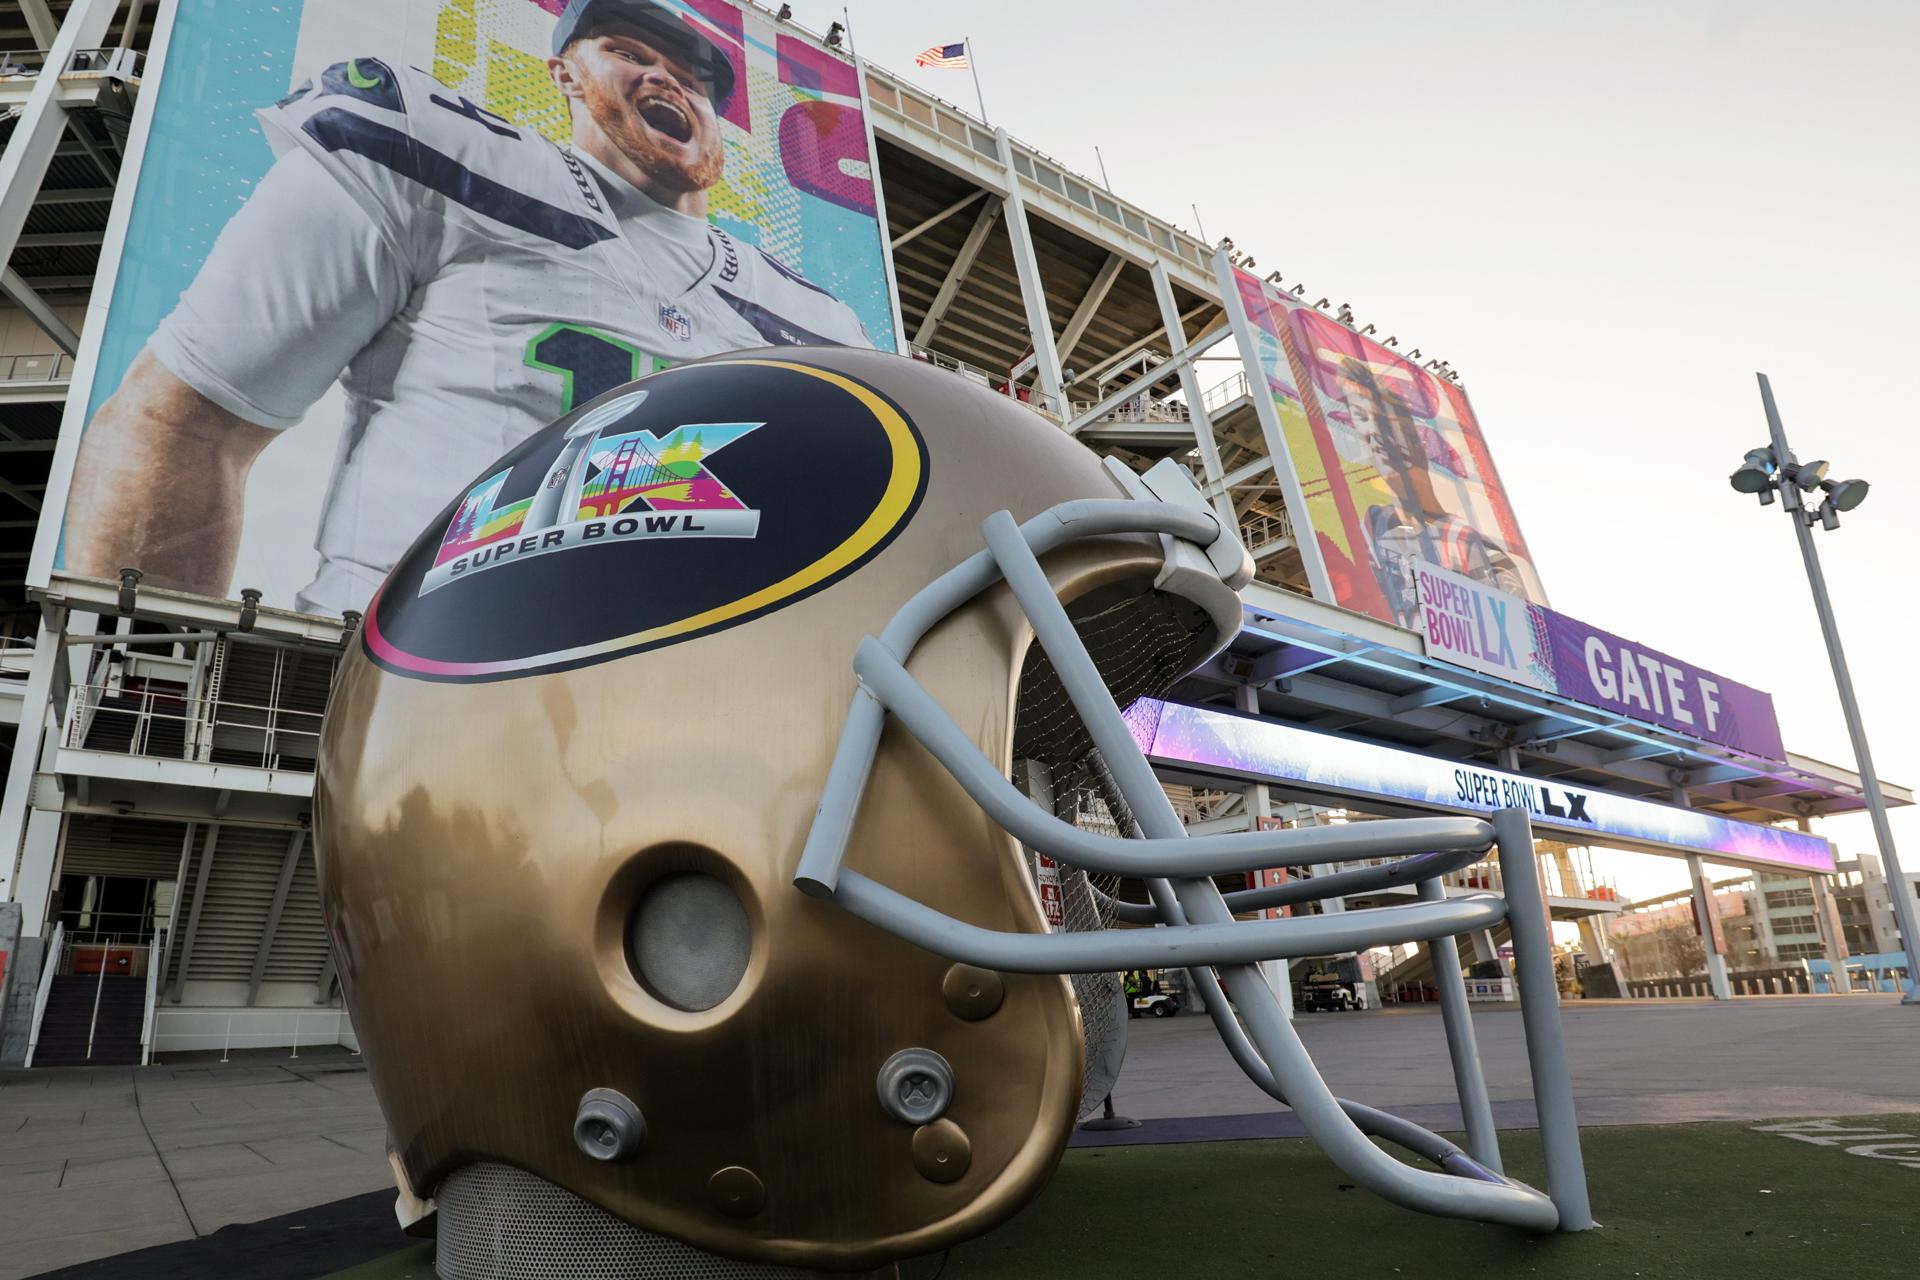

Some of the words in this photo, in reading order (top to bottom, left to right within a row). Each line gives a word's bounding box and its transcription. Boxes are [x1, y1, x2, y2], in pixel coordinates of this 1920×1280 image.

[664, 316, 689, 339] NFL
[449, 529, 565, 577] SUPER
[582, 515, 705, 539] BOWL
[1420, 571, 1473, 620] SUPER
[1426, 607, 1480, 658] BOWL
[1471, 590, 1517, 671] LX
[1584, 636, 1694, 725] GATE
[1697, 676, 1720, 732] F
[1454, 769, 1501, 807] SUPER
[1502, 779, 1541, 814] BOWL
[1540, 786, 1592, 822] LX
